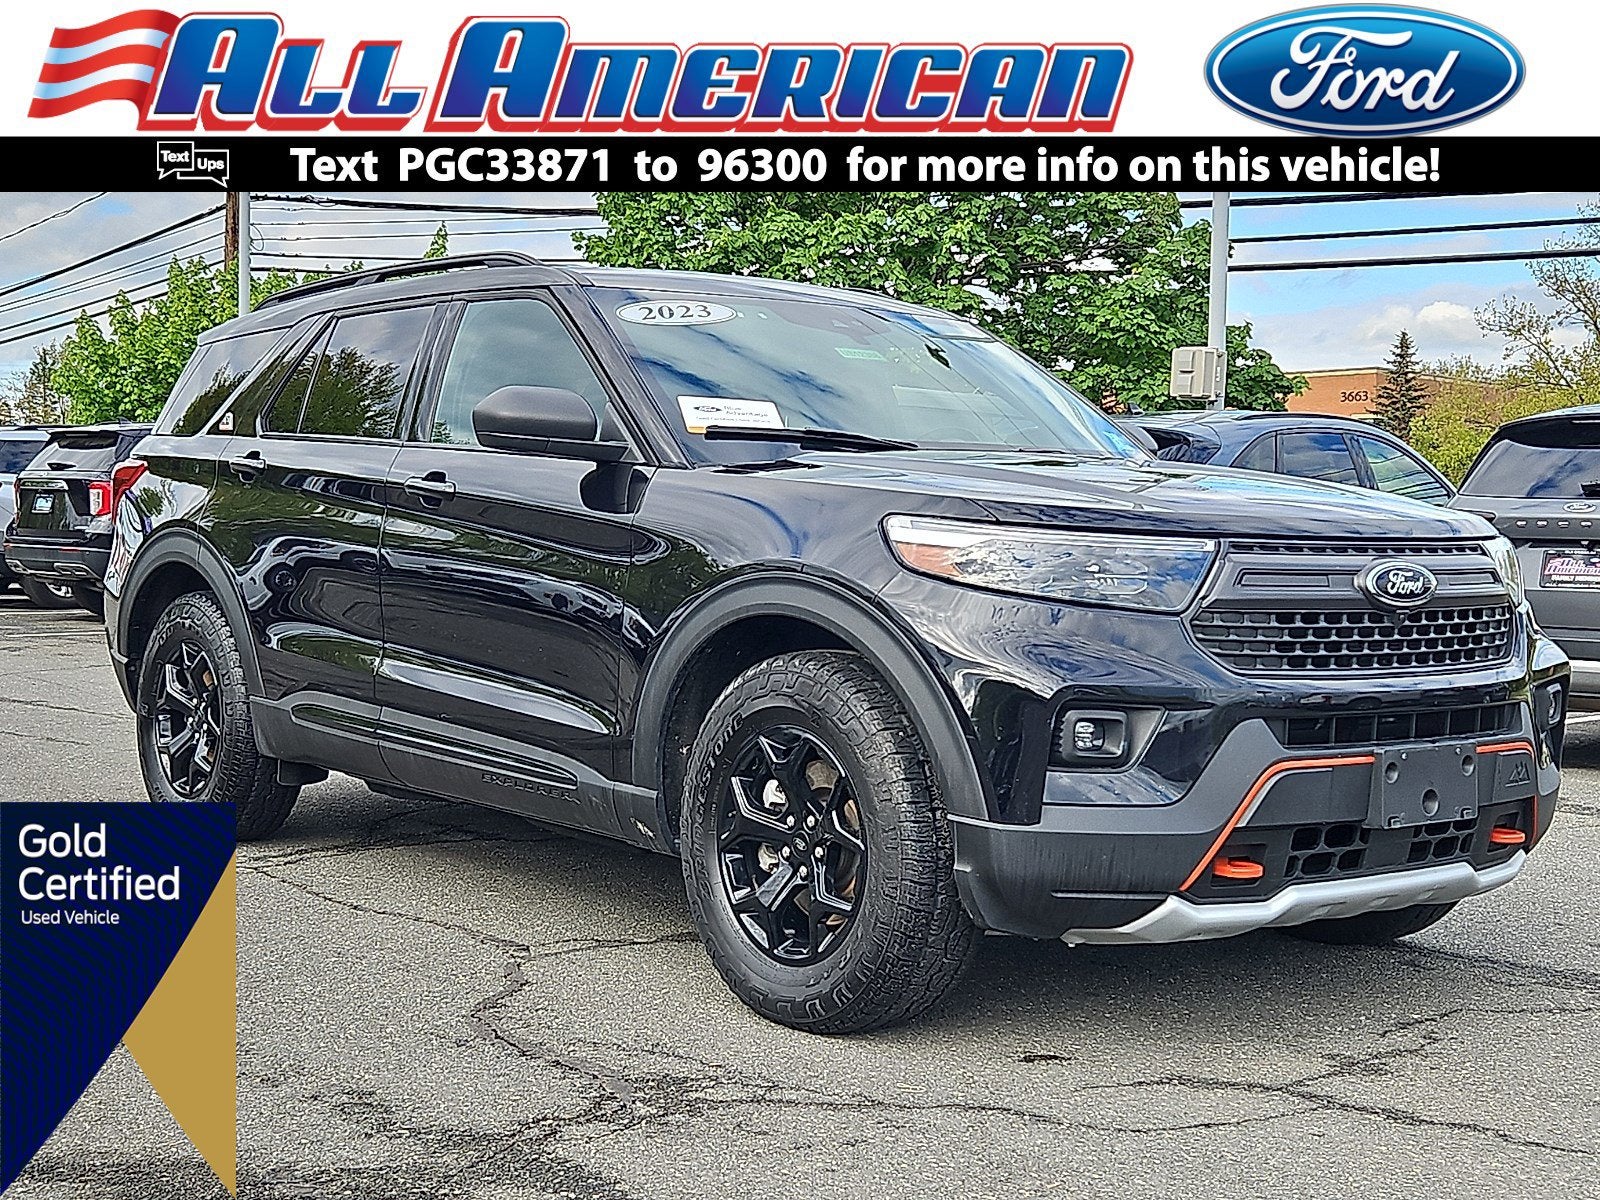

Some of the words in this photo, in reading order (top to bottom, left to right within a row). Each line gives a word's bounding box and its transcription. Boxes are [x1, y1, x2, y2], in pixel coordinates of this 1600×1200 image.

[639, 305, 711, 320] 2023
[1340, 390, 1368, 402] 3663
[1387, 570, 1424, 594] Ford
[481, 773, 581, 805] EXPLORER
[693, 711, 744, 902] BRIDGESTONE
